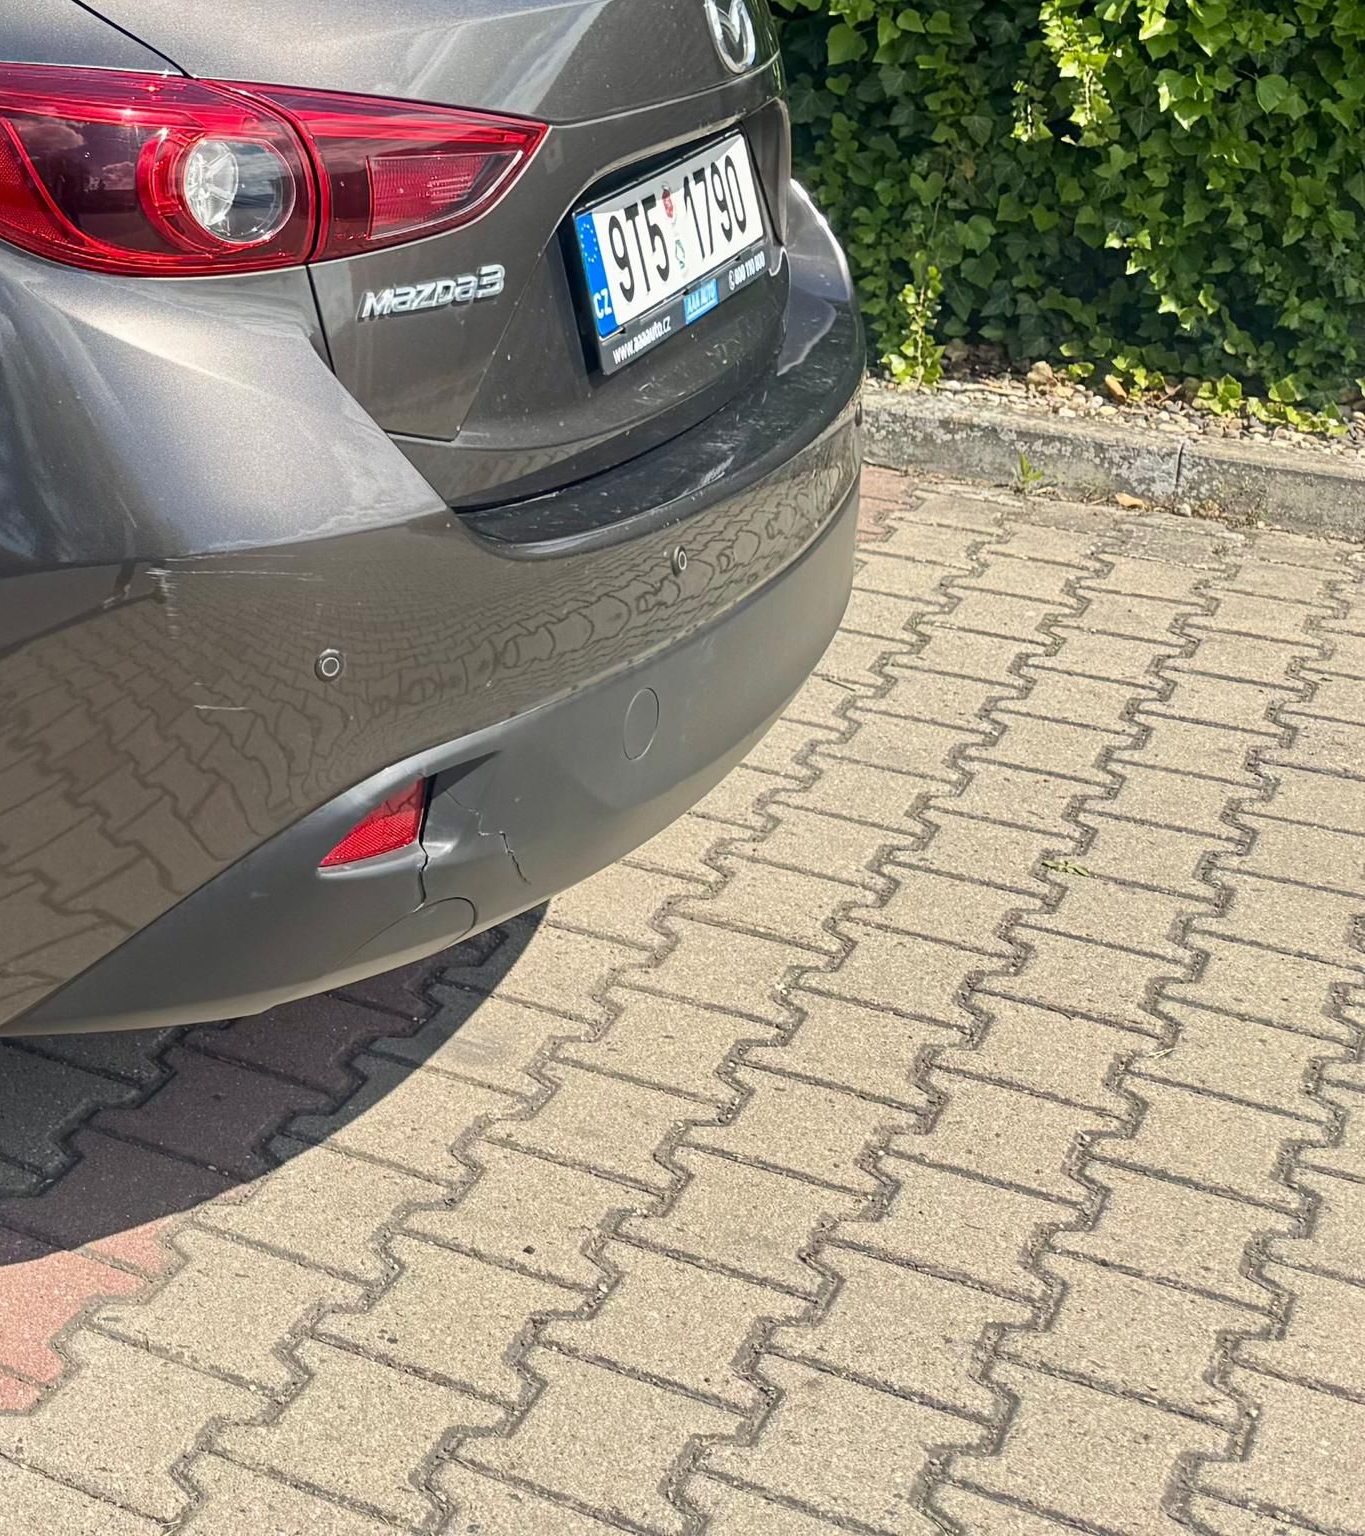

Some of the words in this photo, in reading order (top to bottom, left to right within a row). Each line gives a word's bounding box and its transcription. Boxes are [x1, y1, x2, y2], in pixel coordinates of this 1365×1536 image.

[608, 193, 670, 302] 9T5
[683, 154, 747, 260] 1790
[592, 287, 613, 320] CZ
